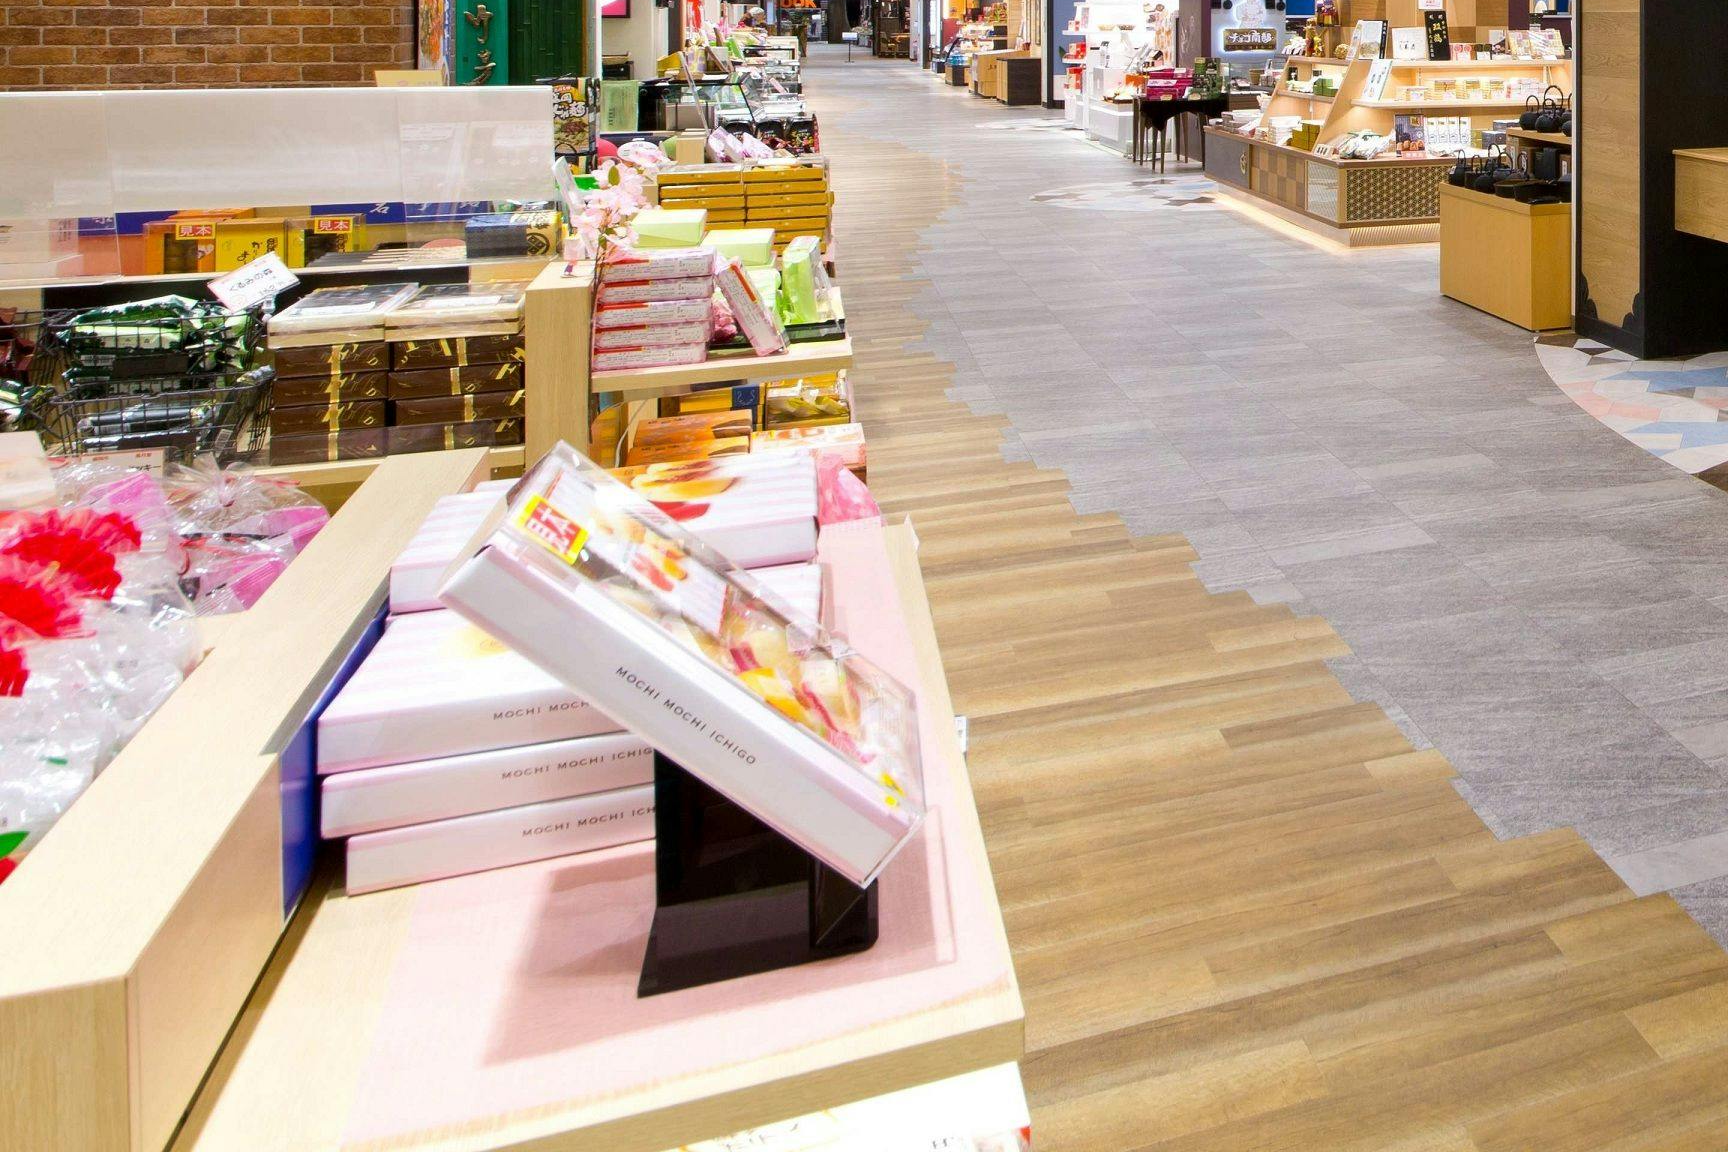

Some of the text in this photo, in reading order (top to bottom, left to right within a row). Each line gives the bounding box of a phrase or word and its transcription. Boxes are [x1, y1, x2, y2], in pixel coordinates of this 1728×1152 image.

[180, 225, 212, 238] 見本
[319, 219, 349, 232] 見本
[493, 706, 542, 721] MOCHI
[616, 666, 757, 766] MOCHI MOCHI ICHIGO
[501, 765, 551, 780] MOCHI
[557, 755, 605, 772] MOCHI
[522, 822, 570, 838] MOCHI
[577, 812, 624, 827] MOCHI
